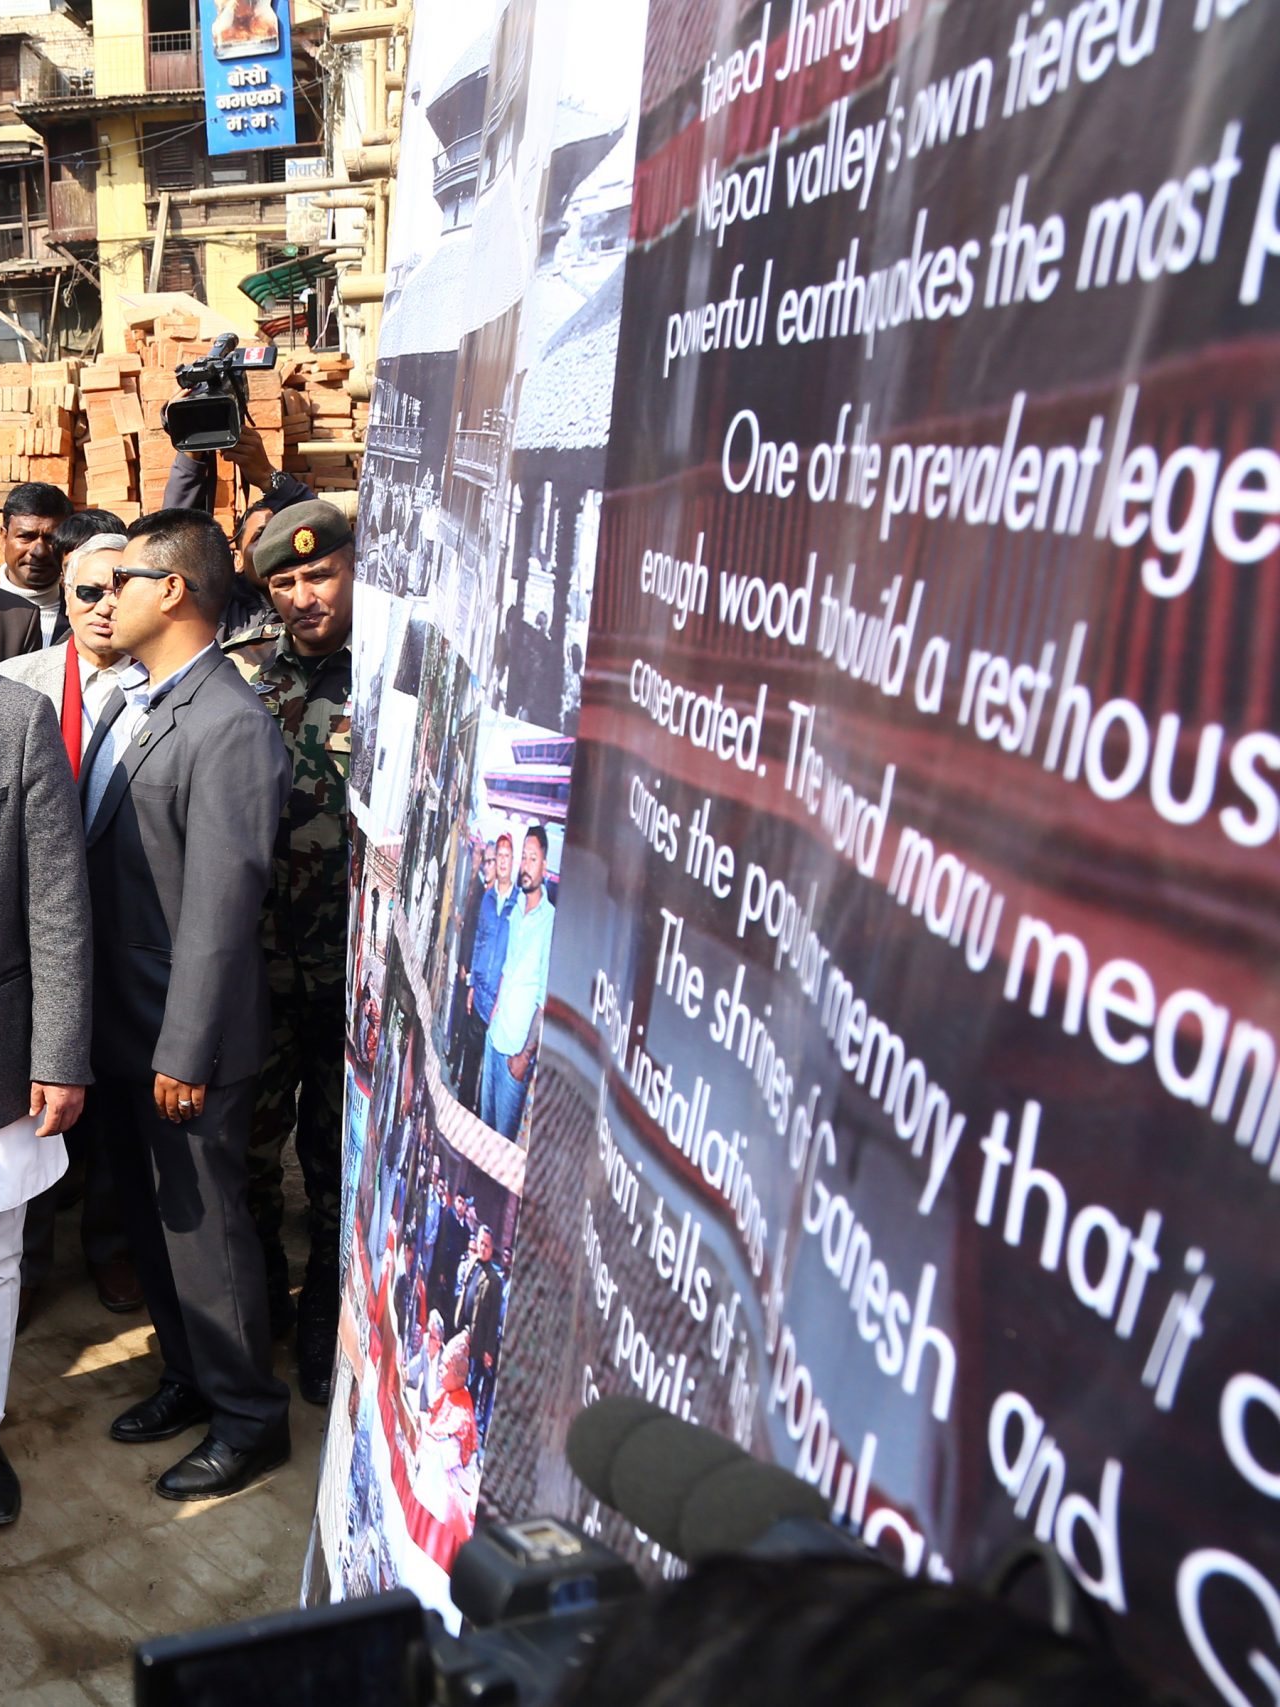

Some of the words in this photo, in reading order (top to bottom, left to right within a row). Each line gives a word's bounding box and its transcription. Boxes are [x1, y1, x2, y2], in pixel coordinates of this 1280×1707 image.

[695, 126, 780, 248] Nepal
[786, 76, 904, 211] valley's
[907, 57, 993, 159] own
[700, 2, 771, 122] tiered
[663, 259, 774, 379] powerful
[776, 208, 981, 360] earthquakes
[983, 174, 1065, 306] the
[1075, 119, 1243, 291] most
[722, 408, 799, 498] One
[807, 402, 852, 502] of
[880, 390, 1104, 542] prevalent
[641, 531, 709, 631] enough
[719, 552, 818, 646] wood
[817, 574, 841, 659] to
[834, 563, 925, 697] build
[914, 636, 960, 714] a
[629, 659, 768, 778] consecrated.
[784, 699, 824, 816] The
[822, 763, 897, 879] word
[658, 907, 705, 1019] The
[709, 964, 794, 1136] shrines
[630, 1024, 768, 1278] installations
[685, 798, 735, 899] the
[736, 862, 831, 1006] popular
[821, 965, 967, 1215] memory
[975, 1098, 1163, 1339] that
[1140, 1246, 1215, 1413] it
[788, 1083, 822, 1172] of
[649, 1196, 711, 1322] tells
[711, 1292, 742, 1377] of
[801, 1120, 958, 1422] Ganesh
[987, 1389, 1128, 1615] and
